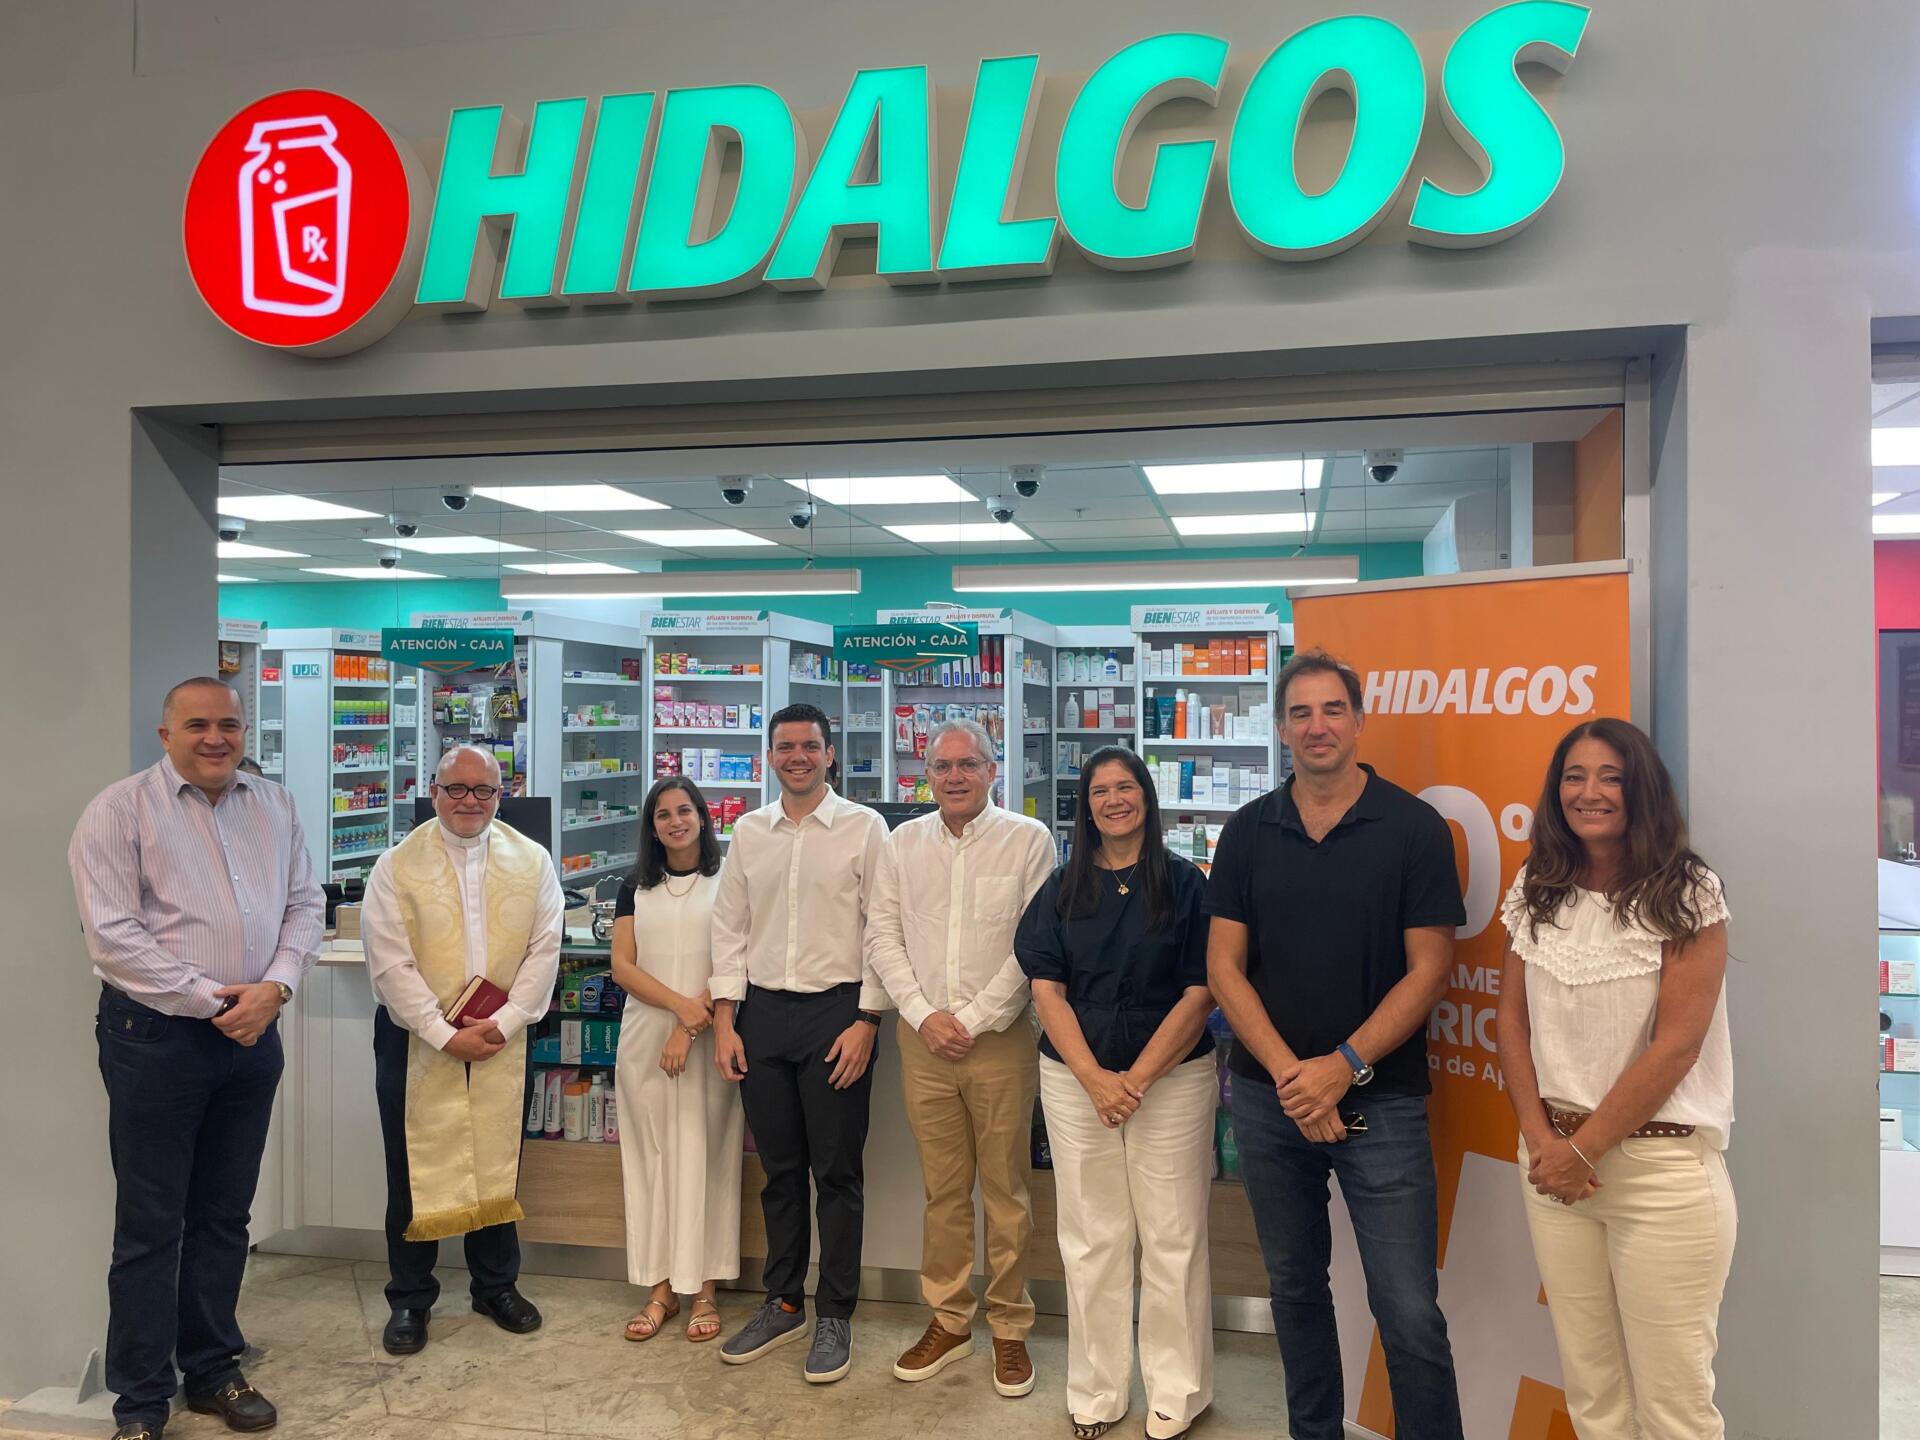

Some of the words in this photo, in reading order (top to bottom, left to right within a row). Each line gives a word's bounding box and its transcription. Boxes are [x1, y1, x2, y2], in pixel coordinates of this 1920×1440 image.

[413, 0, 1592, 306] HIDALGOS
[421, 618, 469, 629] BIENESTAR
[651, 616, 701, 629] BIENESTAR
[1143, 611, 1200, 624] BIENESTAR
[390, 636, 457, 650] ATENCIÓN
[470, 639, 505, 650] CAJA
[843, 633, 916, 648] ATENCIÓN
[930, 635, 968, 646] CAJA
[1364, 665, 1598, 716] HIDALGOS
[1426, 1000, 1497, 1053] RIC
[1446, 1056, 1476, 1077] de
